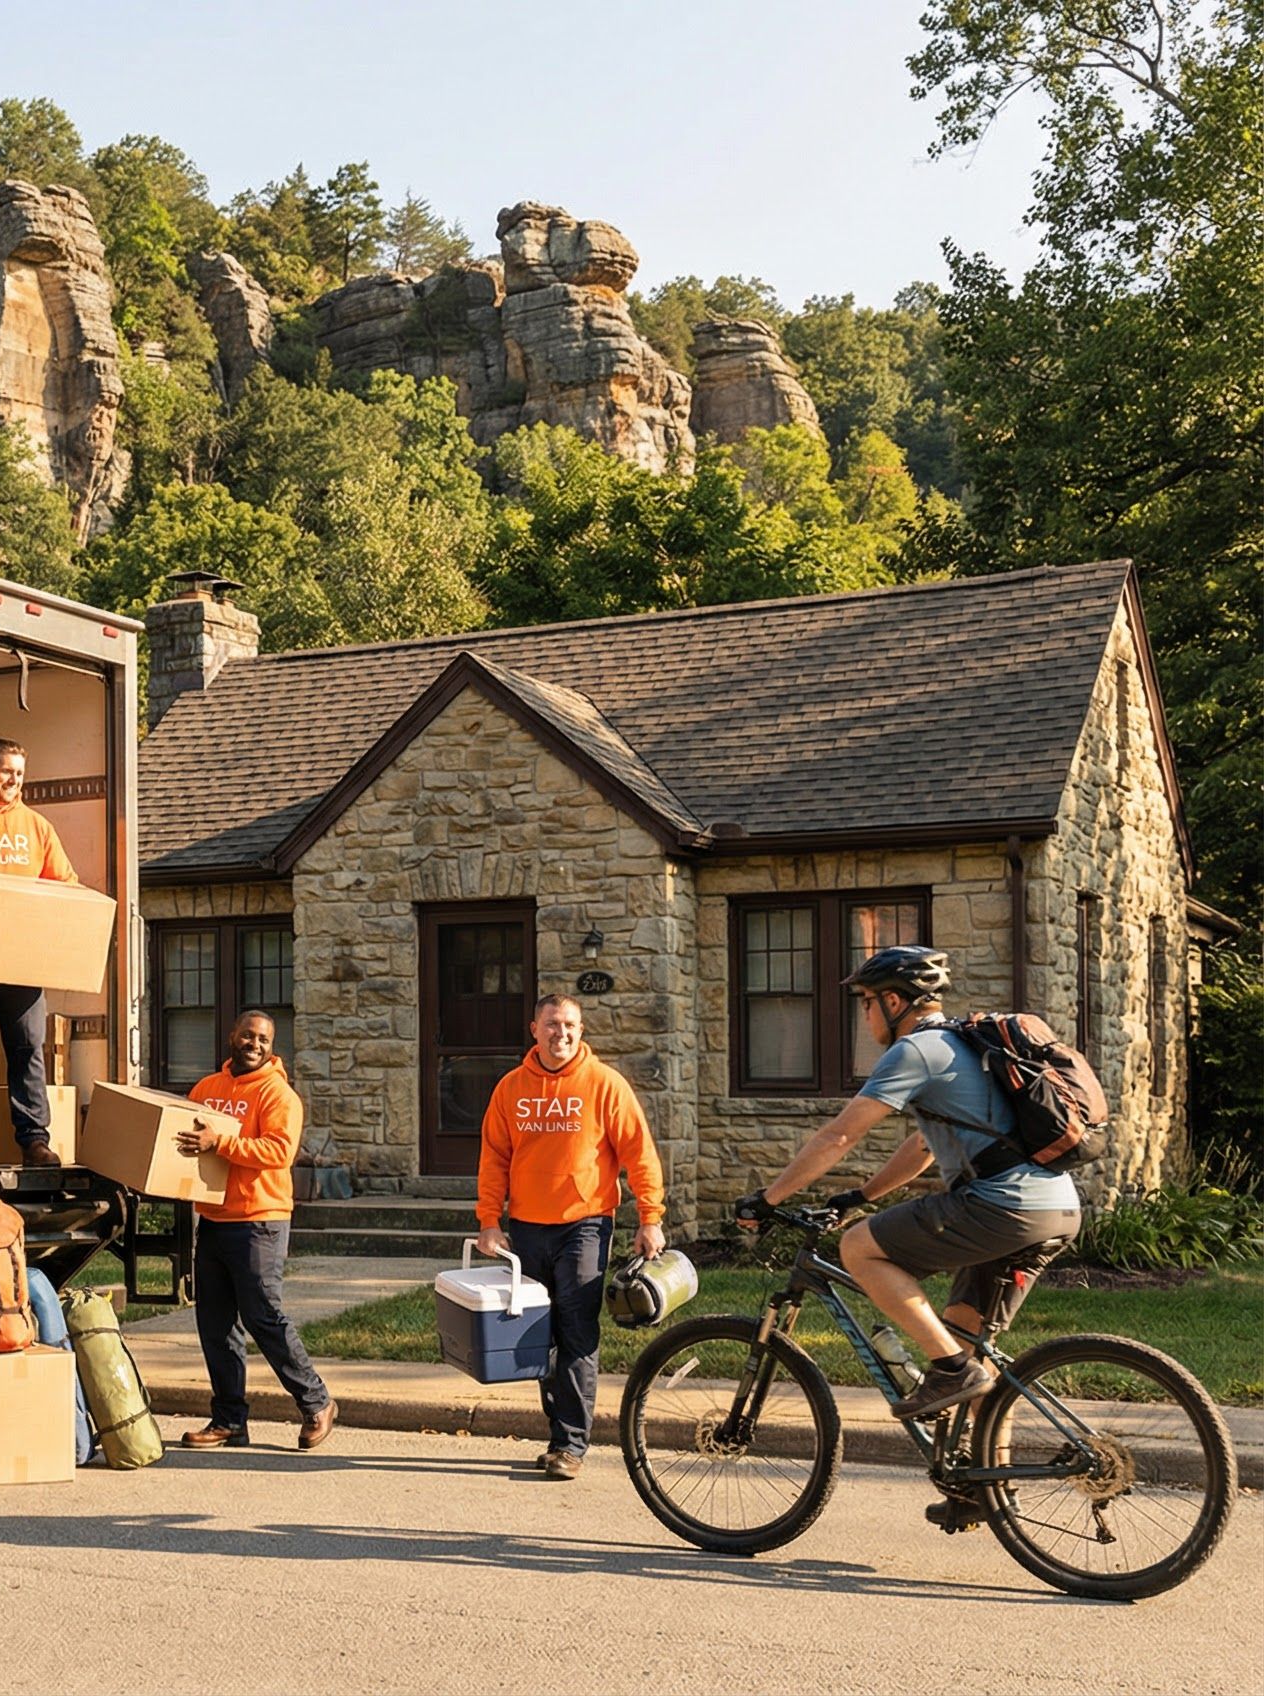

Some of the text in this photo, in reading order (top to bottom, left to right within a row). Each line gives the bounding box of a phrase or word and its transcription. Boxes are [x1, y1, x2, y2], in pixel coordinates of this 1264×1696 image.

[516, 1097, 583, 1118] STAR
[516, 1121, 582, 1132] VAN LINES
